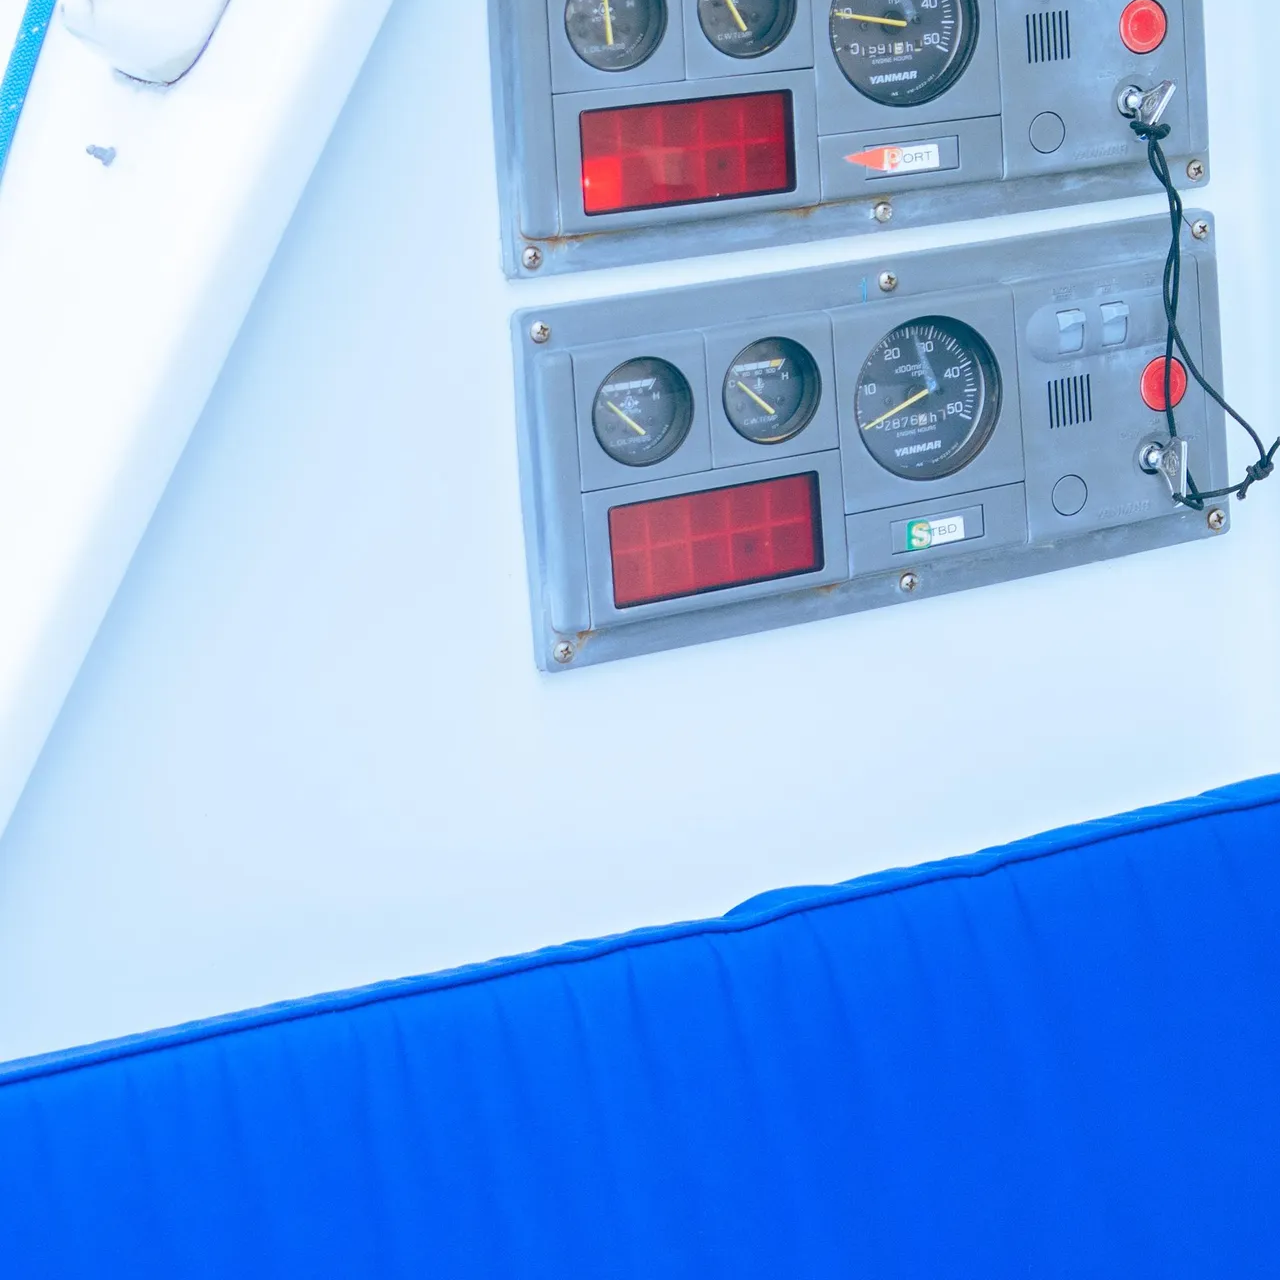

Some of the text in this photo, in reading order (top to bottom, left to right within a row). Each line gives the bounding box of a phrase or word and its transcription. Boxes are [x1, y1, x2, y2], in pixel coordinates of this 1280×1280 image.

[923, 32, 940, 45] 50
[869, 70, 918, 85] YANMAR
[883, 148, 932, 170] PORT
[916, 340, 934, 353] 30
[884, 347, 901, 361] 20
[781, 371, 789, 381] H
[943, 365, 960, 379] 40
[728, 380, 736, 388] C
[864, 382, 877, 396] 10
[946, 401, 963, 414] 50
[894, 439, 942, 457] YANMAR
[911, 522, 957, 548] STBD
